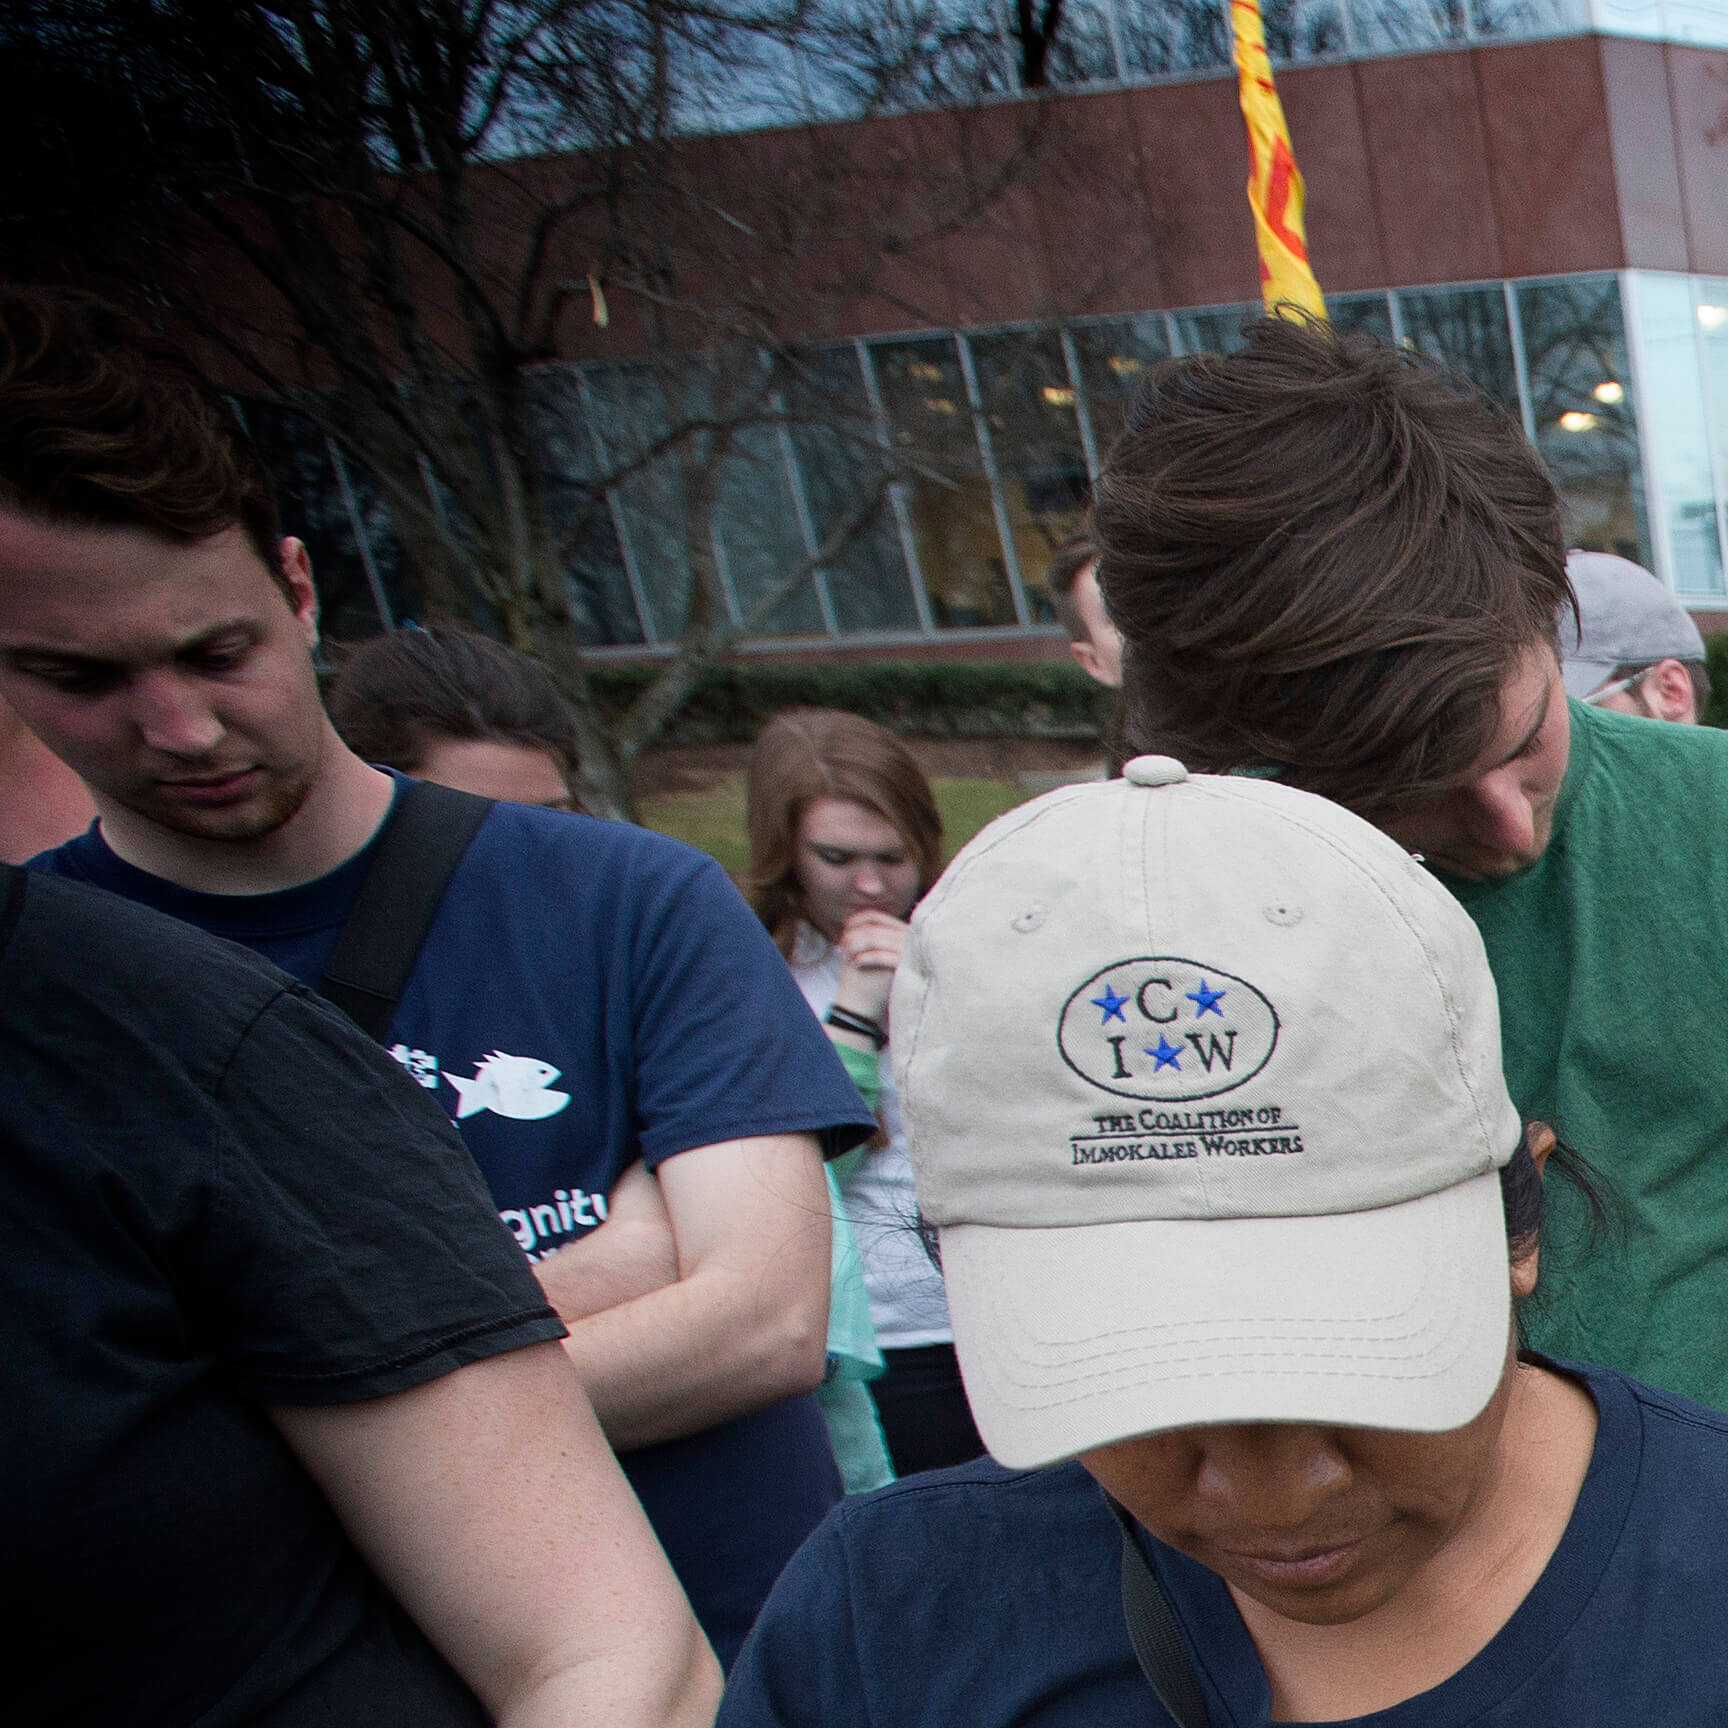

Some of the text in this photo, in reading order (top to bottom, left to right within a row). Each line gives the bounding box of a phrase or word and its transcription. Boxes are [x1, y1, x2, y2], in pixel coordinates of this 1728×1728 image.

[1136, 979, 1178, 1024] C
[1106, 1030, 1240, 1080] I W
[1094, 1106, 1282, 1133] THE COALITION OF
[1071, 1135, 1305, 1166] IMMOKALEE WORKERS
